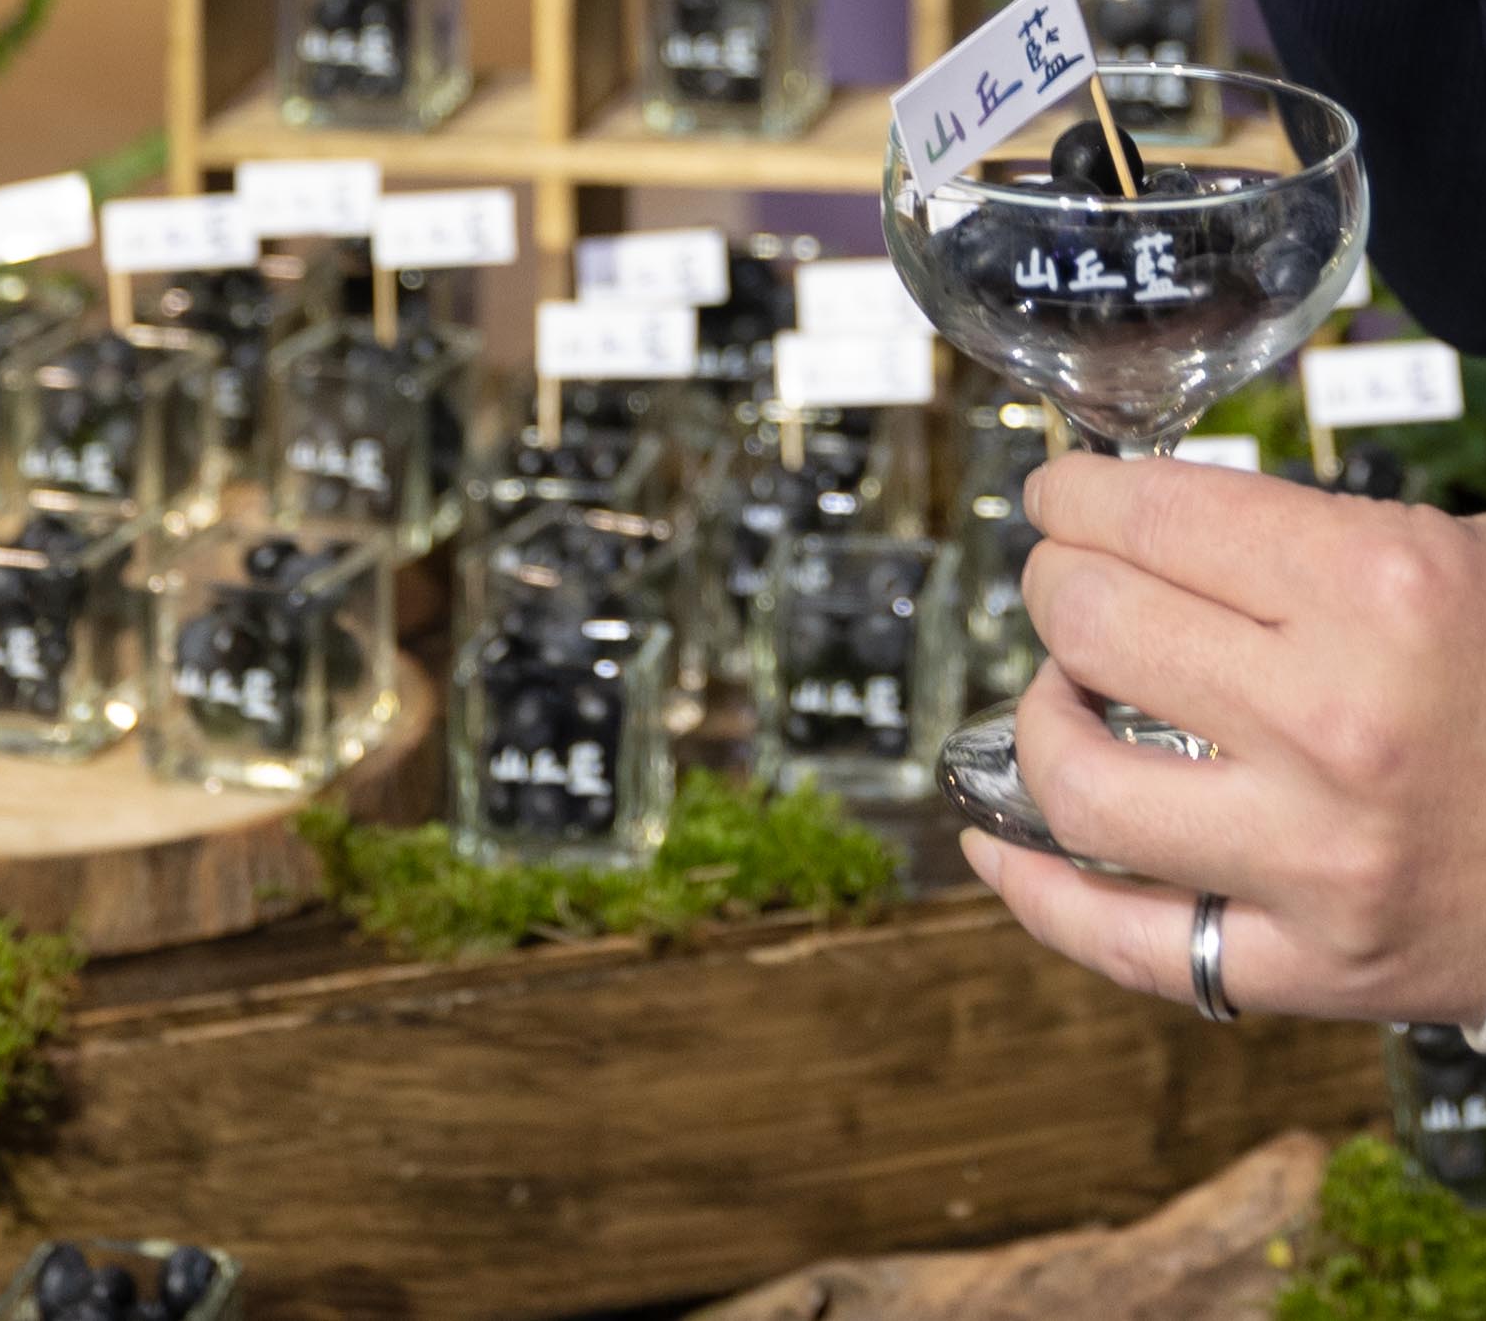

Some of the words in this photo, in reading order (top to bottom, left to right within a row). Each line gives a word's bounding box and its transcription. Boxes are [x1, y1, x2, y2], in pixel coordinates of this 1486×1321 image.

[923, 5, 1086, 164] 山丘藍
[1014, 230, 1193, 302] 山丘藍
